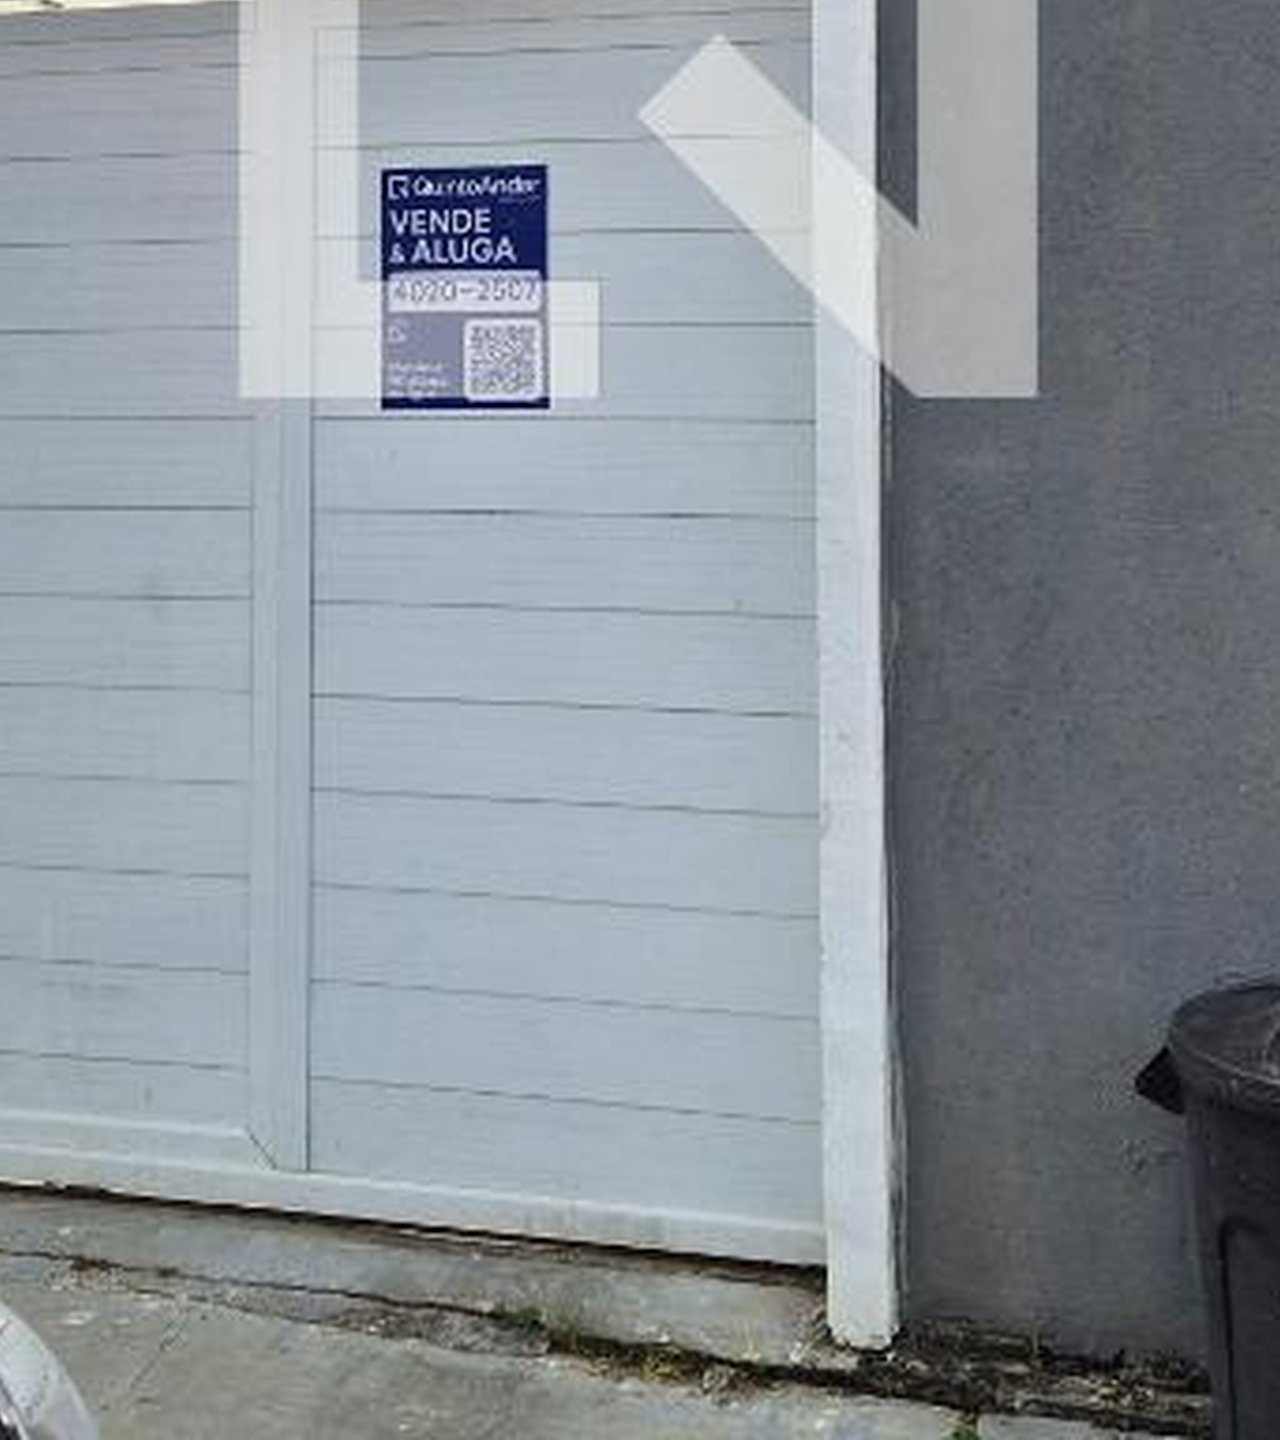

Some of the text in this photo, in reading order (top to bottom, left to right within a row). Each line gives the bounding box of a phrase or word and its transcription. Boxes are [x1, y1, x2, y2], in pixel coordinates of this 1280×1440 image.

[389, 208, 491, 236] VENDE
[389, 236, 518, 263] & ALUGA
[394, 276, 537, 302] 4020-2507
